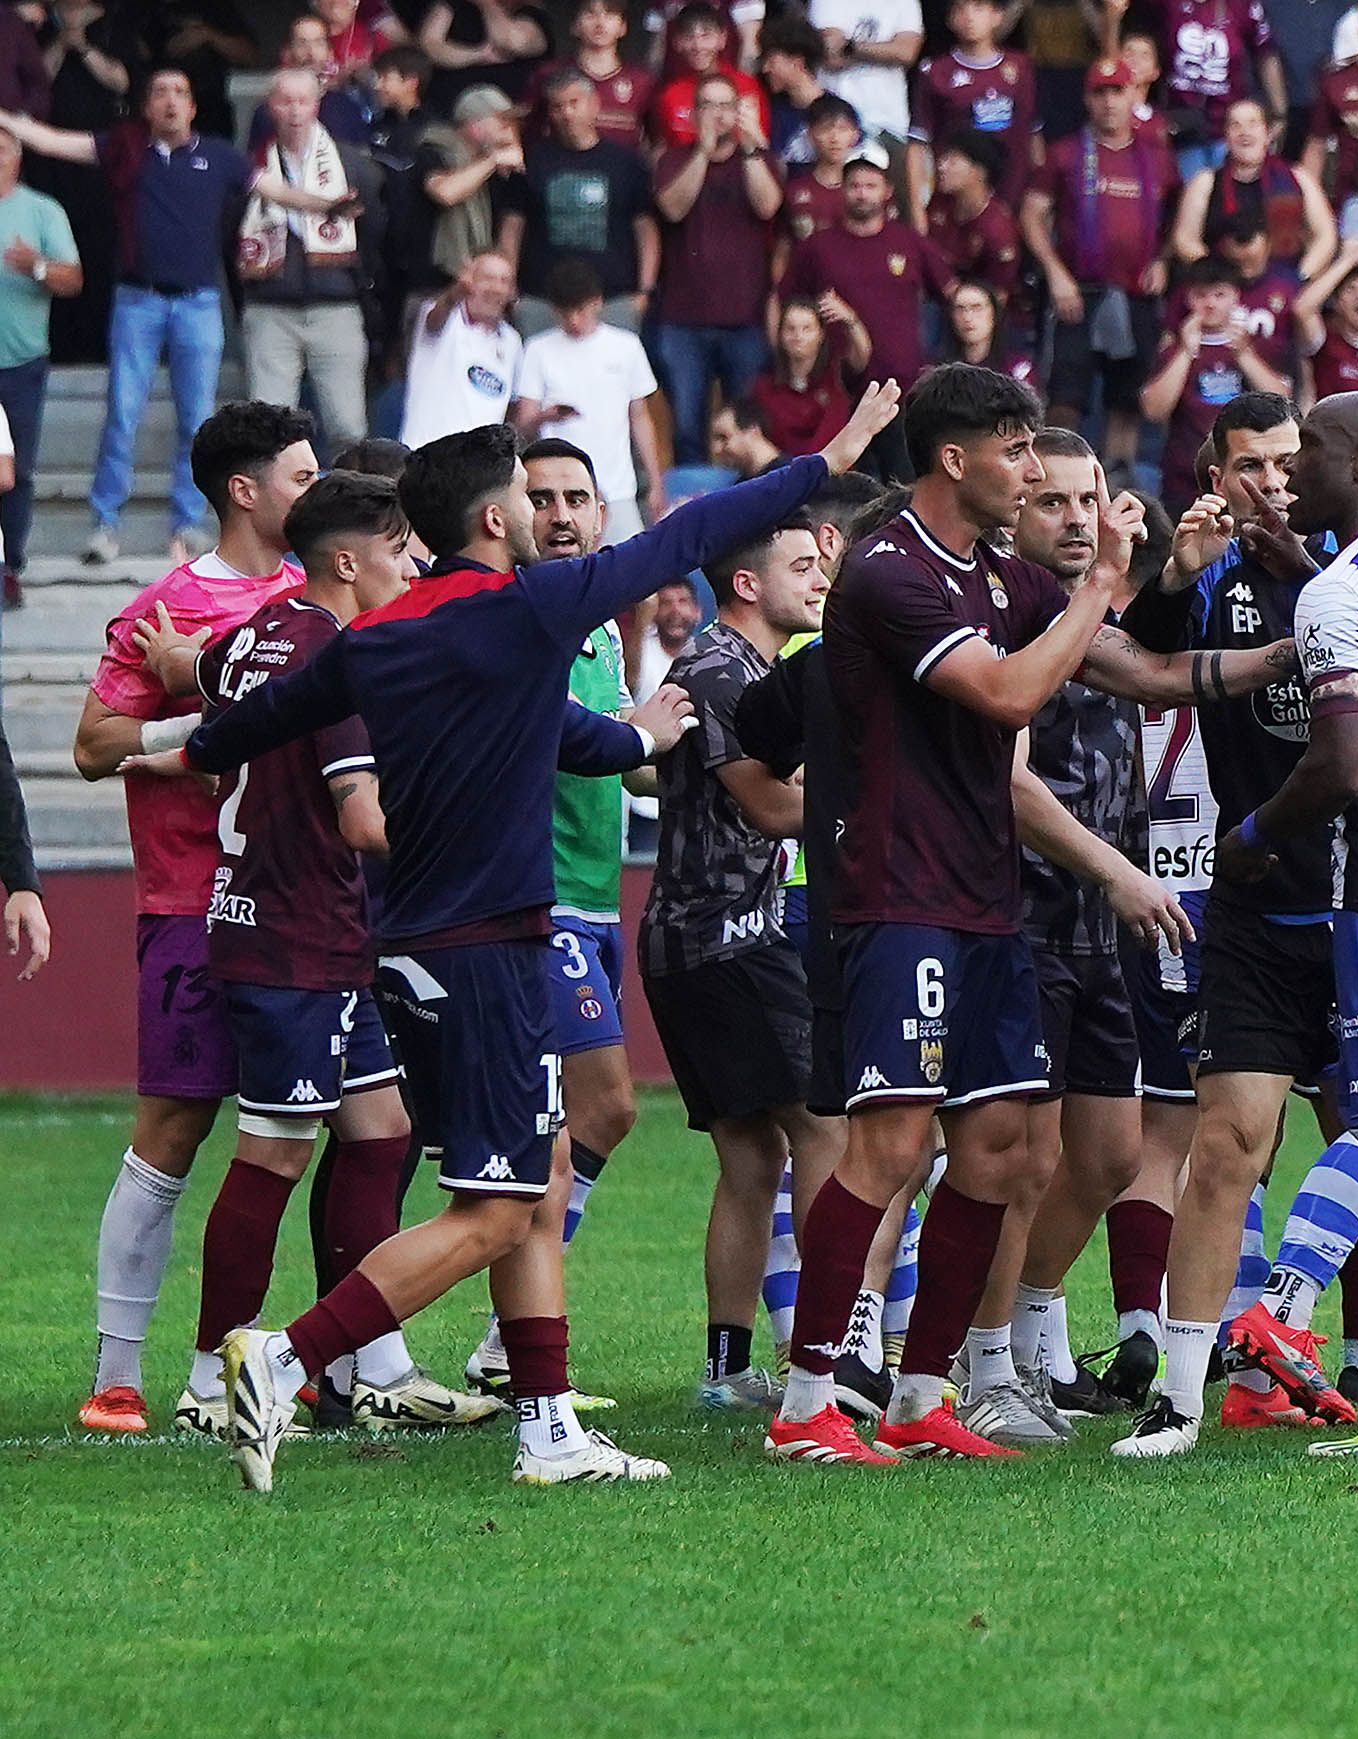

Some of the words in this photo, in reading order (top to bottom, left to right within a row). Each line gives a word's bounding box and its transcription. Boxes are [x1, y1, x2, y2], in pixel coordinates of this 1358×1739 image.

[1232, 604, 1262, 633] EP
[552, 931, 588, 979] 3
[916, 957, 945, 1018] 6
